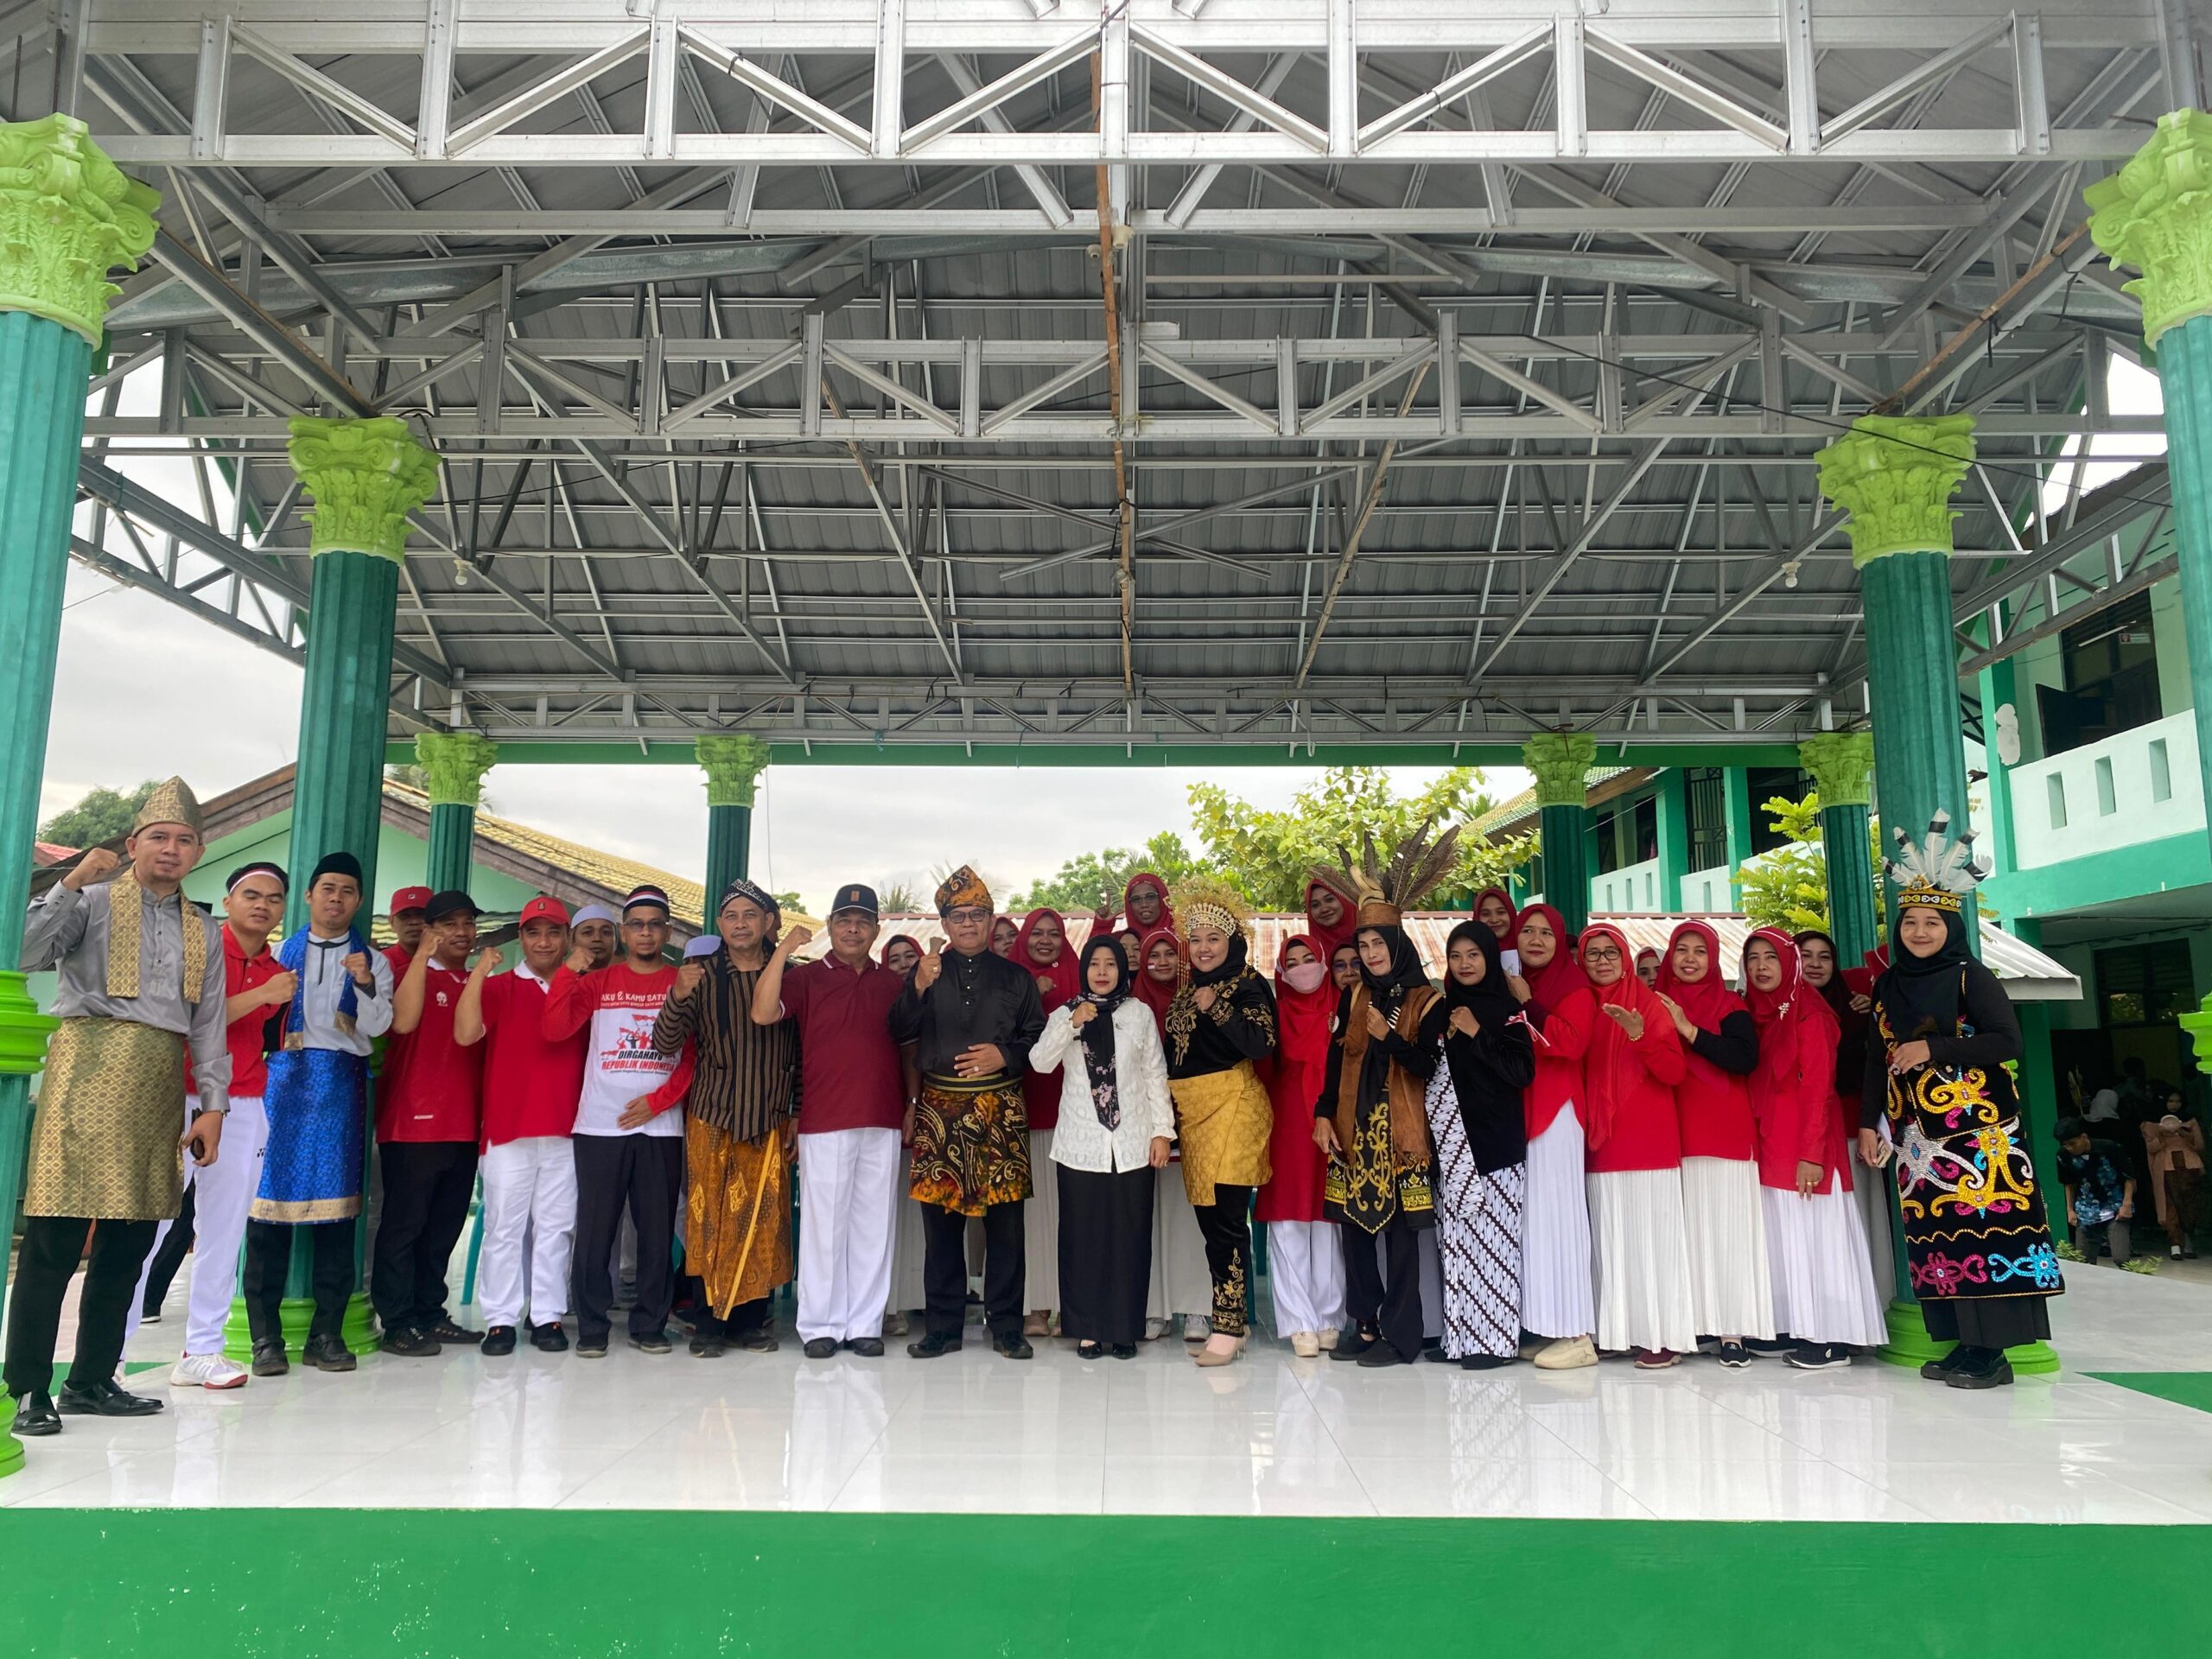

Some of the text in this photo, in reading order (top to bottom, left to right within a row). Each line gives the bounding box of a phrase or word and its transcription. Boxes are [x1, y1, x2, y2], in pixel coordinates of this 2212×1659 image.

[617, 991, 623, 1001] &
[618, 1051, 663, 1060] DIRGAHAYU
[602, 1059, 674, 1071] REPUBLIK INDONESIA
